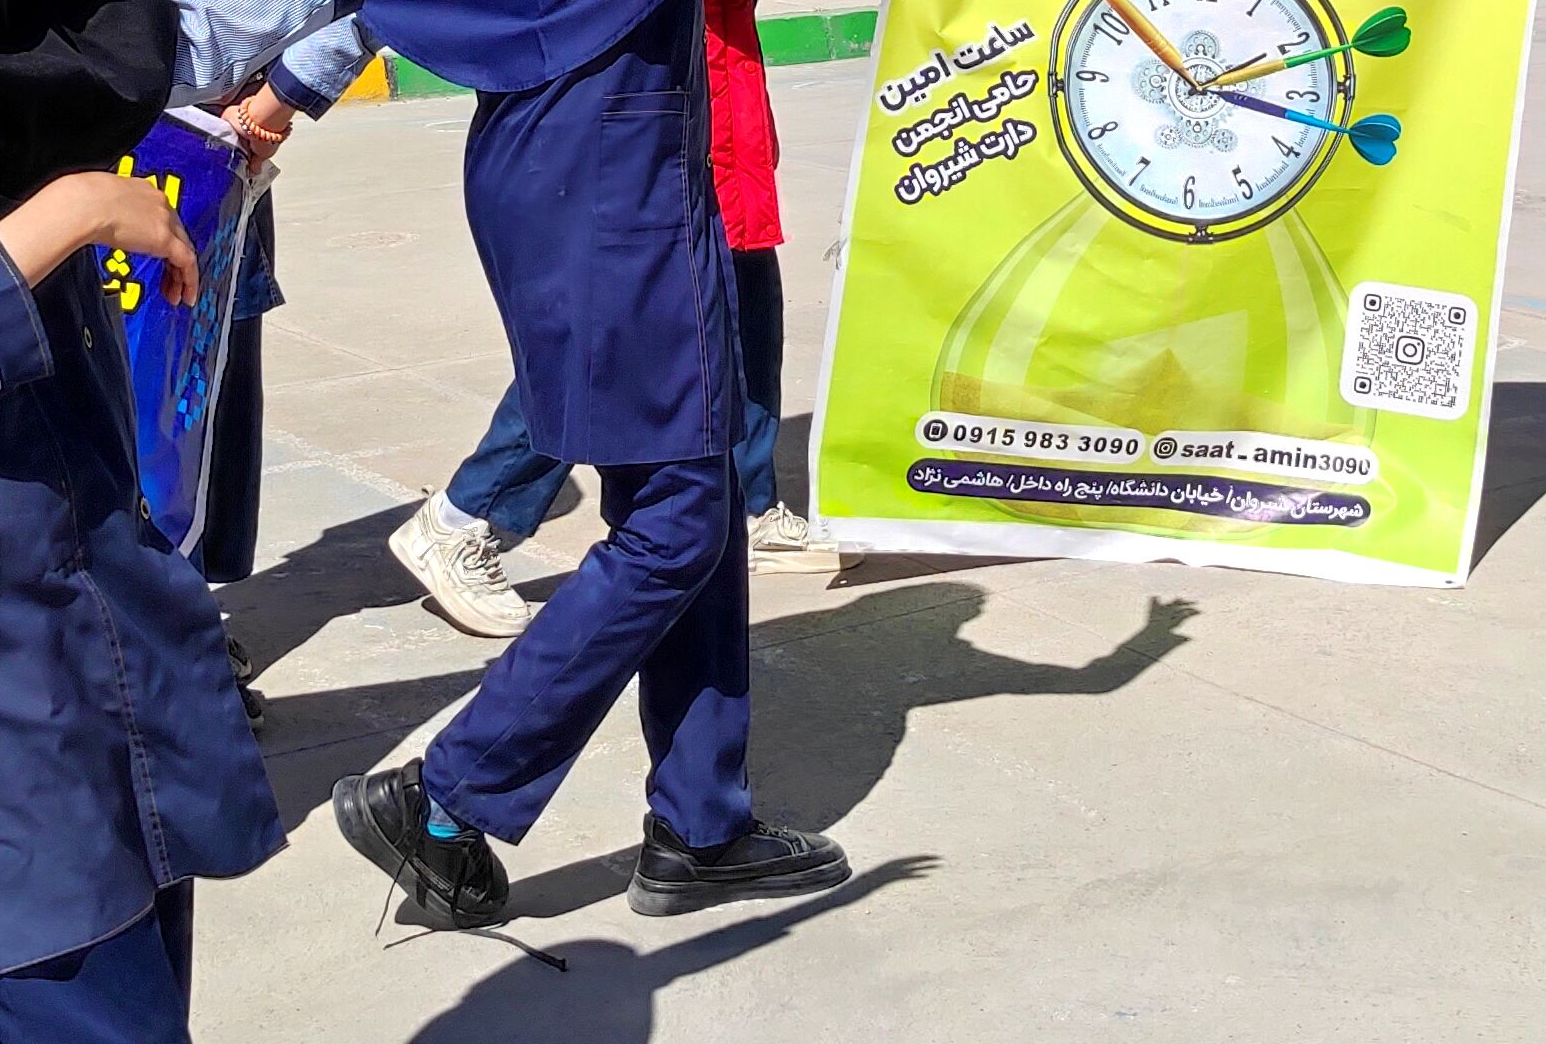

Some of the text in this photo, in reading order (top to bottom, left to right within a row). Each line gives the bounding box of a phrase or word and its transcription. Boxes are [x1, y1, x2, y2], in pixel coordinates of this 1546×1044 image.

[1093, 11, 1130, 46] 10
[1277, 31, 1310, 55] 2
[880, 22, 1035, 111] ساعت امین
[1076, 69, 1109, 83] 9
[1286, 89, 1320, 103] 3
[895, 73, 1037, 153] حامی انجمن
[1088, 121, 1118, 140] 8
[1271, 135, 1301, 158] 4
[898, 122, 1034, 201] دارت شیروان
[1129, 156, 1151, 186] 7
[1183, 175, 1196, 209] 6
[1232, 164, 1253, 200] 5
[953, 424, 1139, 456] 0915 983 3090
[913, 466, 942, 486] نژاد
[943, 471, 1004, 489] هاشمی
[1054, 477, 1072, 497] راه
[1073, 481, 1103, 499] پنج
[1170, 482, 1224, 505] خیابان
